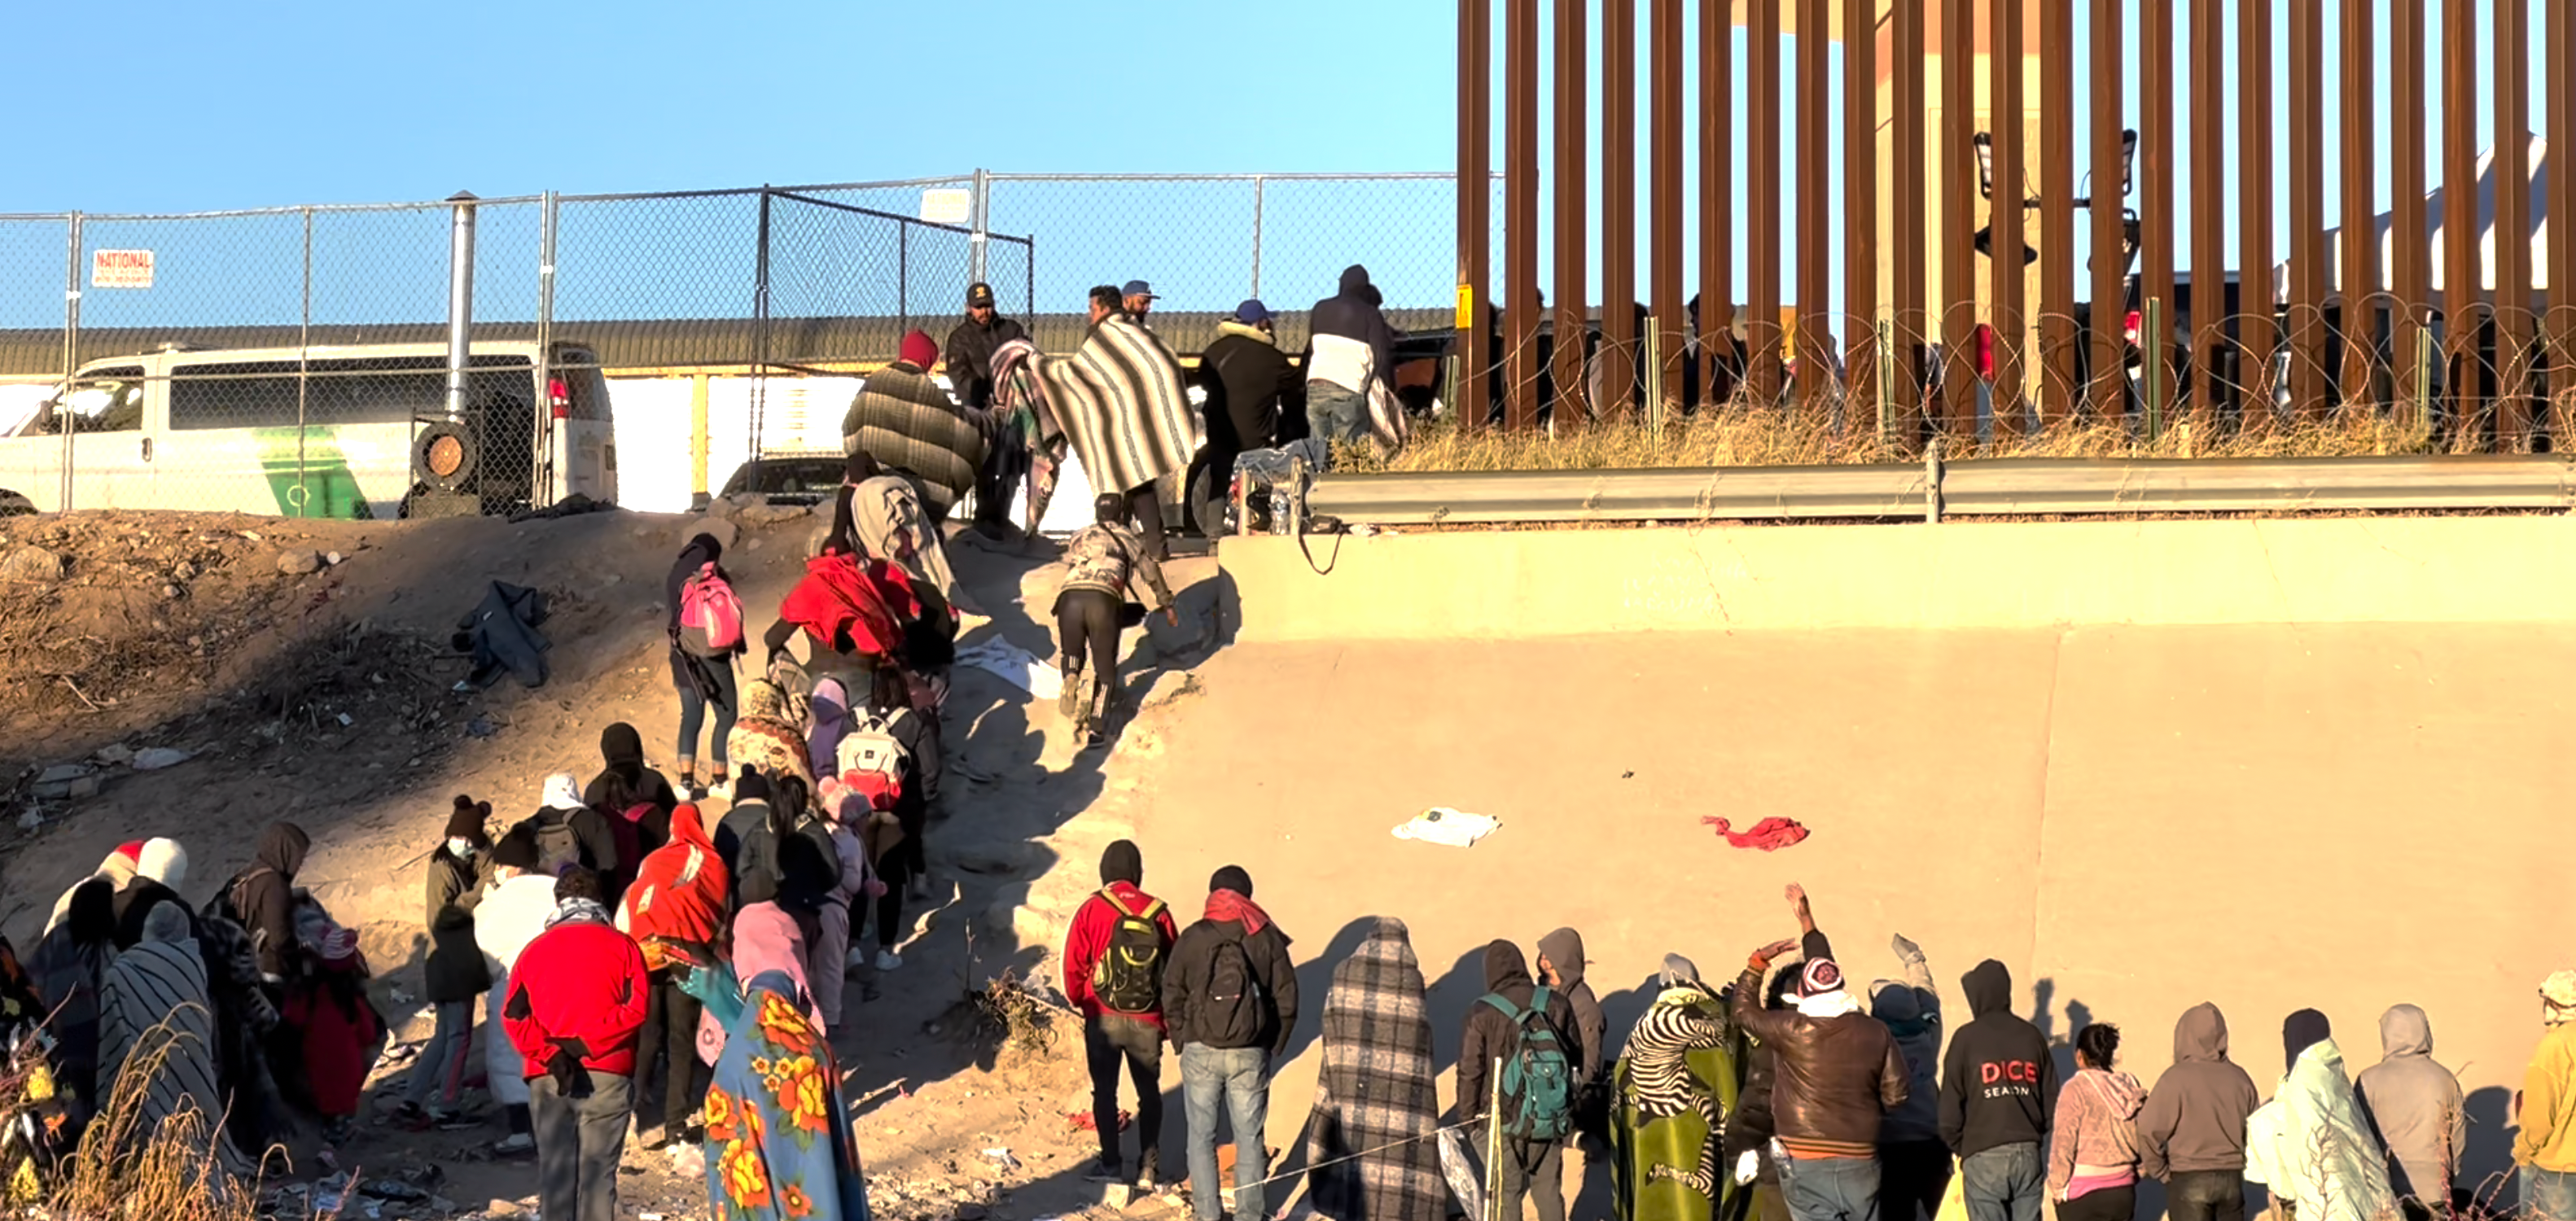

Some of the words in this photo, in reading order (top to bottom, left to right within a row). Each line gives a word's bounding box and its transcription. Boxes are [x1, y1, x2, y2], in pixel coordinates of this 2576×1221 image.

[97, 252, 151, 269] NATIONAL
[1981, 1061, 2036, 1083] DICE
[1984, 1086, 2029, 1099] SEAON
